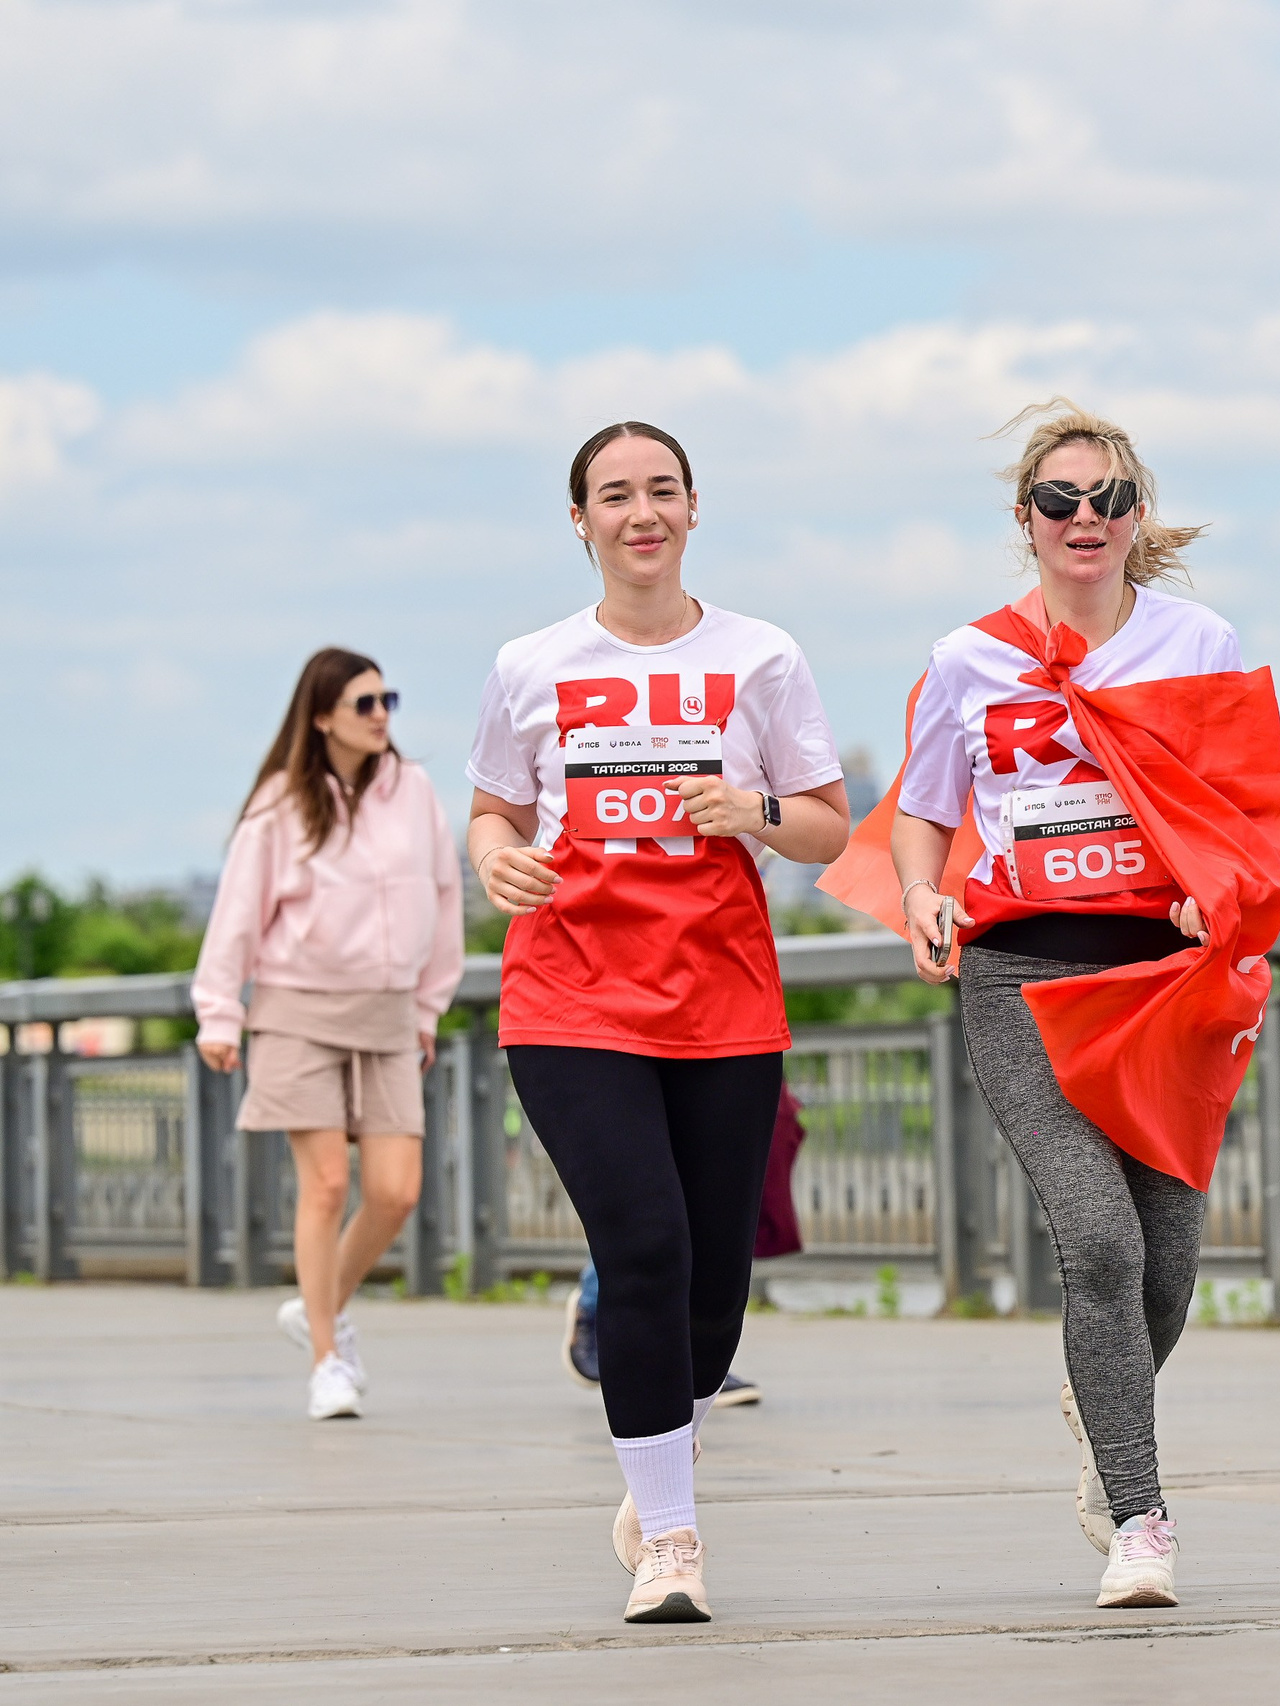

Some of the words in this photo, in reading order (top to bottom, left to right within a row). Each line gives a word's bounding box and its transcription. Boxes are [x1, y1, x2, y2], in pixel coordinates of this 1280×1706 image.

[555, 673, 735, 748] RU
[585, 741, 600, 749] ПСБ
[984, 699, 1080, 776] R
[592, 764, 665, 775] ТАТАРСТАН
[668, 763, 698, 772] 2026
[1031, 802, 1046, 810] ПСБ
[1040, 819, 1111, 835] ТАТАРСТАН
[1114, 816, 1136, 827] 202
[1043, 839, 1146, 883] 605
